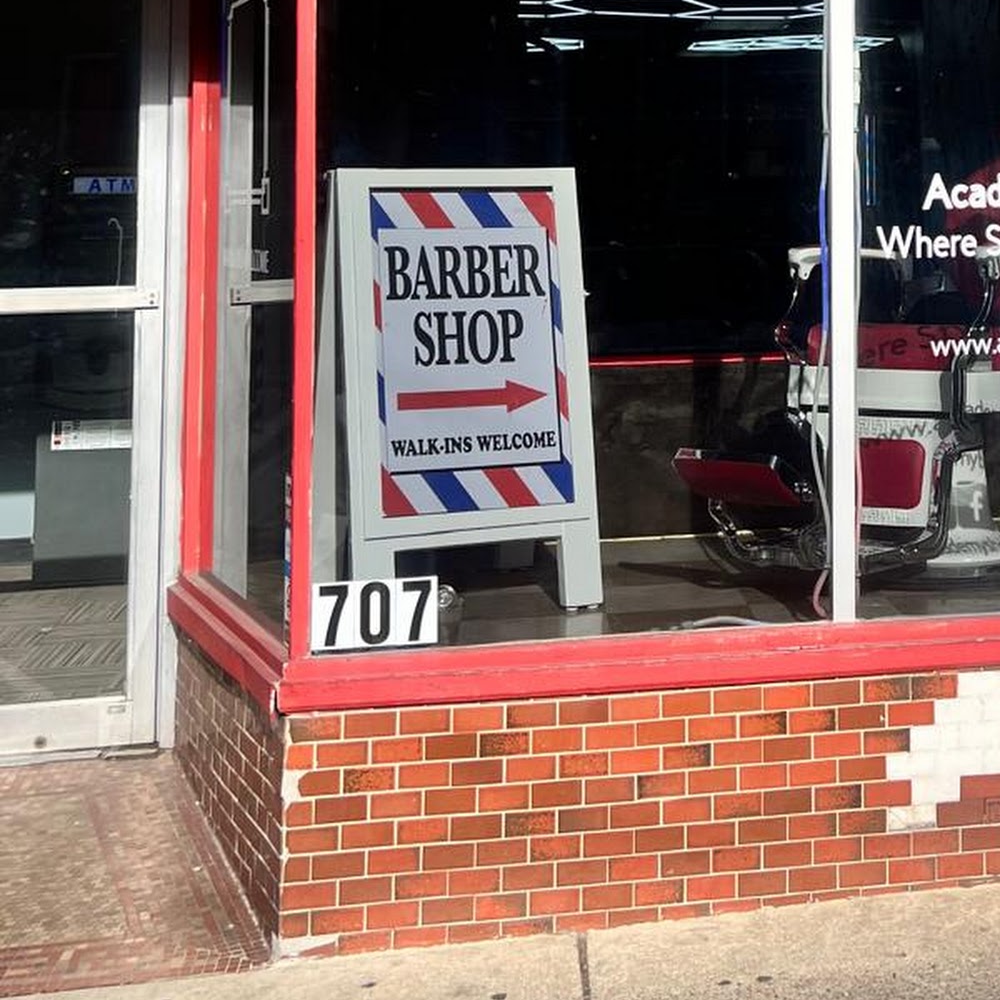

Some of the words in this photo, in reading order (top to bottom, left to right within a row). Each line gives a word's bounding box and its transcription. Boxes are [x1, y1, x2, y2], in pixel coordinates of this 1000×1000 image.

[88, 178, 135, 193] ATM
[876, 225, 977, 260] Where
[384, 243, 546, 301] BARBER
[413, 309, 524, 367] SHOP
[391, 436, 473, 457] WALK-INS
[477, 431, 557, 452] WELCOME
[318, 580, 433, 649] 707
